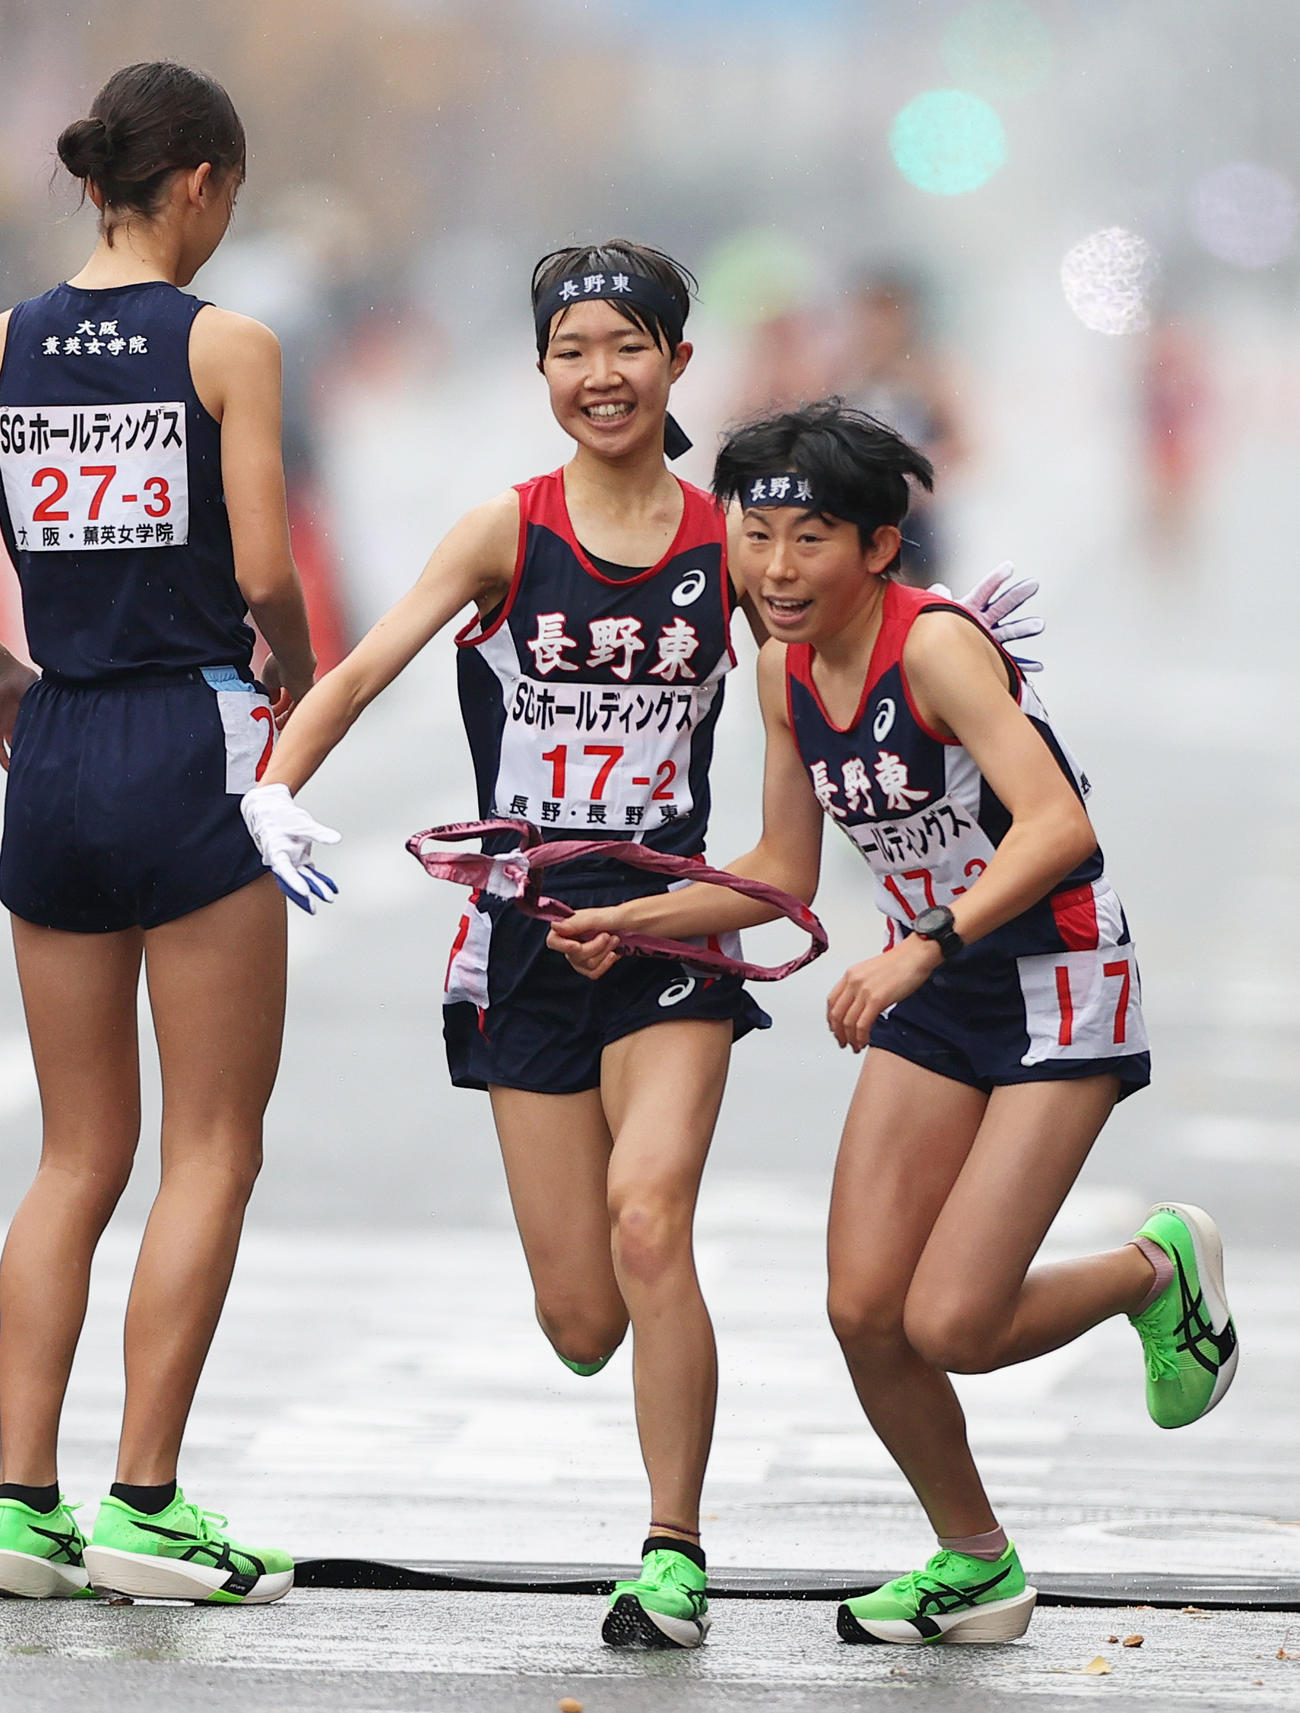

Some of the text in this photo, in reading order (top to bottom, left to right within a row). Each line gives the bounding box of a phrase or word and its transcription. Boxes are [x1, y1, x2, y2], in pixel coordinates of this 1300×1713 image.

[558, 272, 633, 301] 長野東
[41, 336, 149, 356] 薫英女学院
[76, 320, 119, 336] 大阪
[0, 408, 183, 455] SGホールディングス
[31, 465, 172, 522] 27-3
[749, 476, 814, 502] 長野東
[527, 612, 700, 682] 長野東
[512, 682, 693, 734] SGホールディングス
[542, 744, 677, 801] 17-2
[809, 750, 931, 819] 長野東
[509, 795, 679, 825] 長野・長野東
[851, 804, 971, 864] ールディングス
[1055, 959, 1130, 1046] 17
